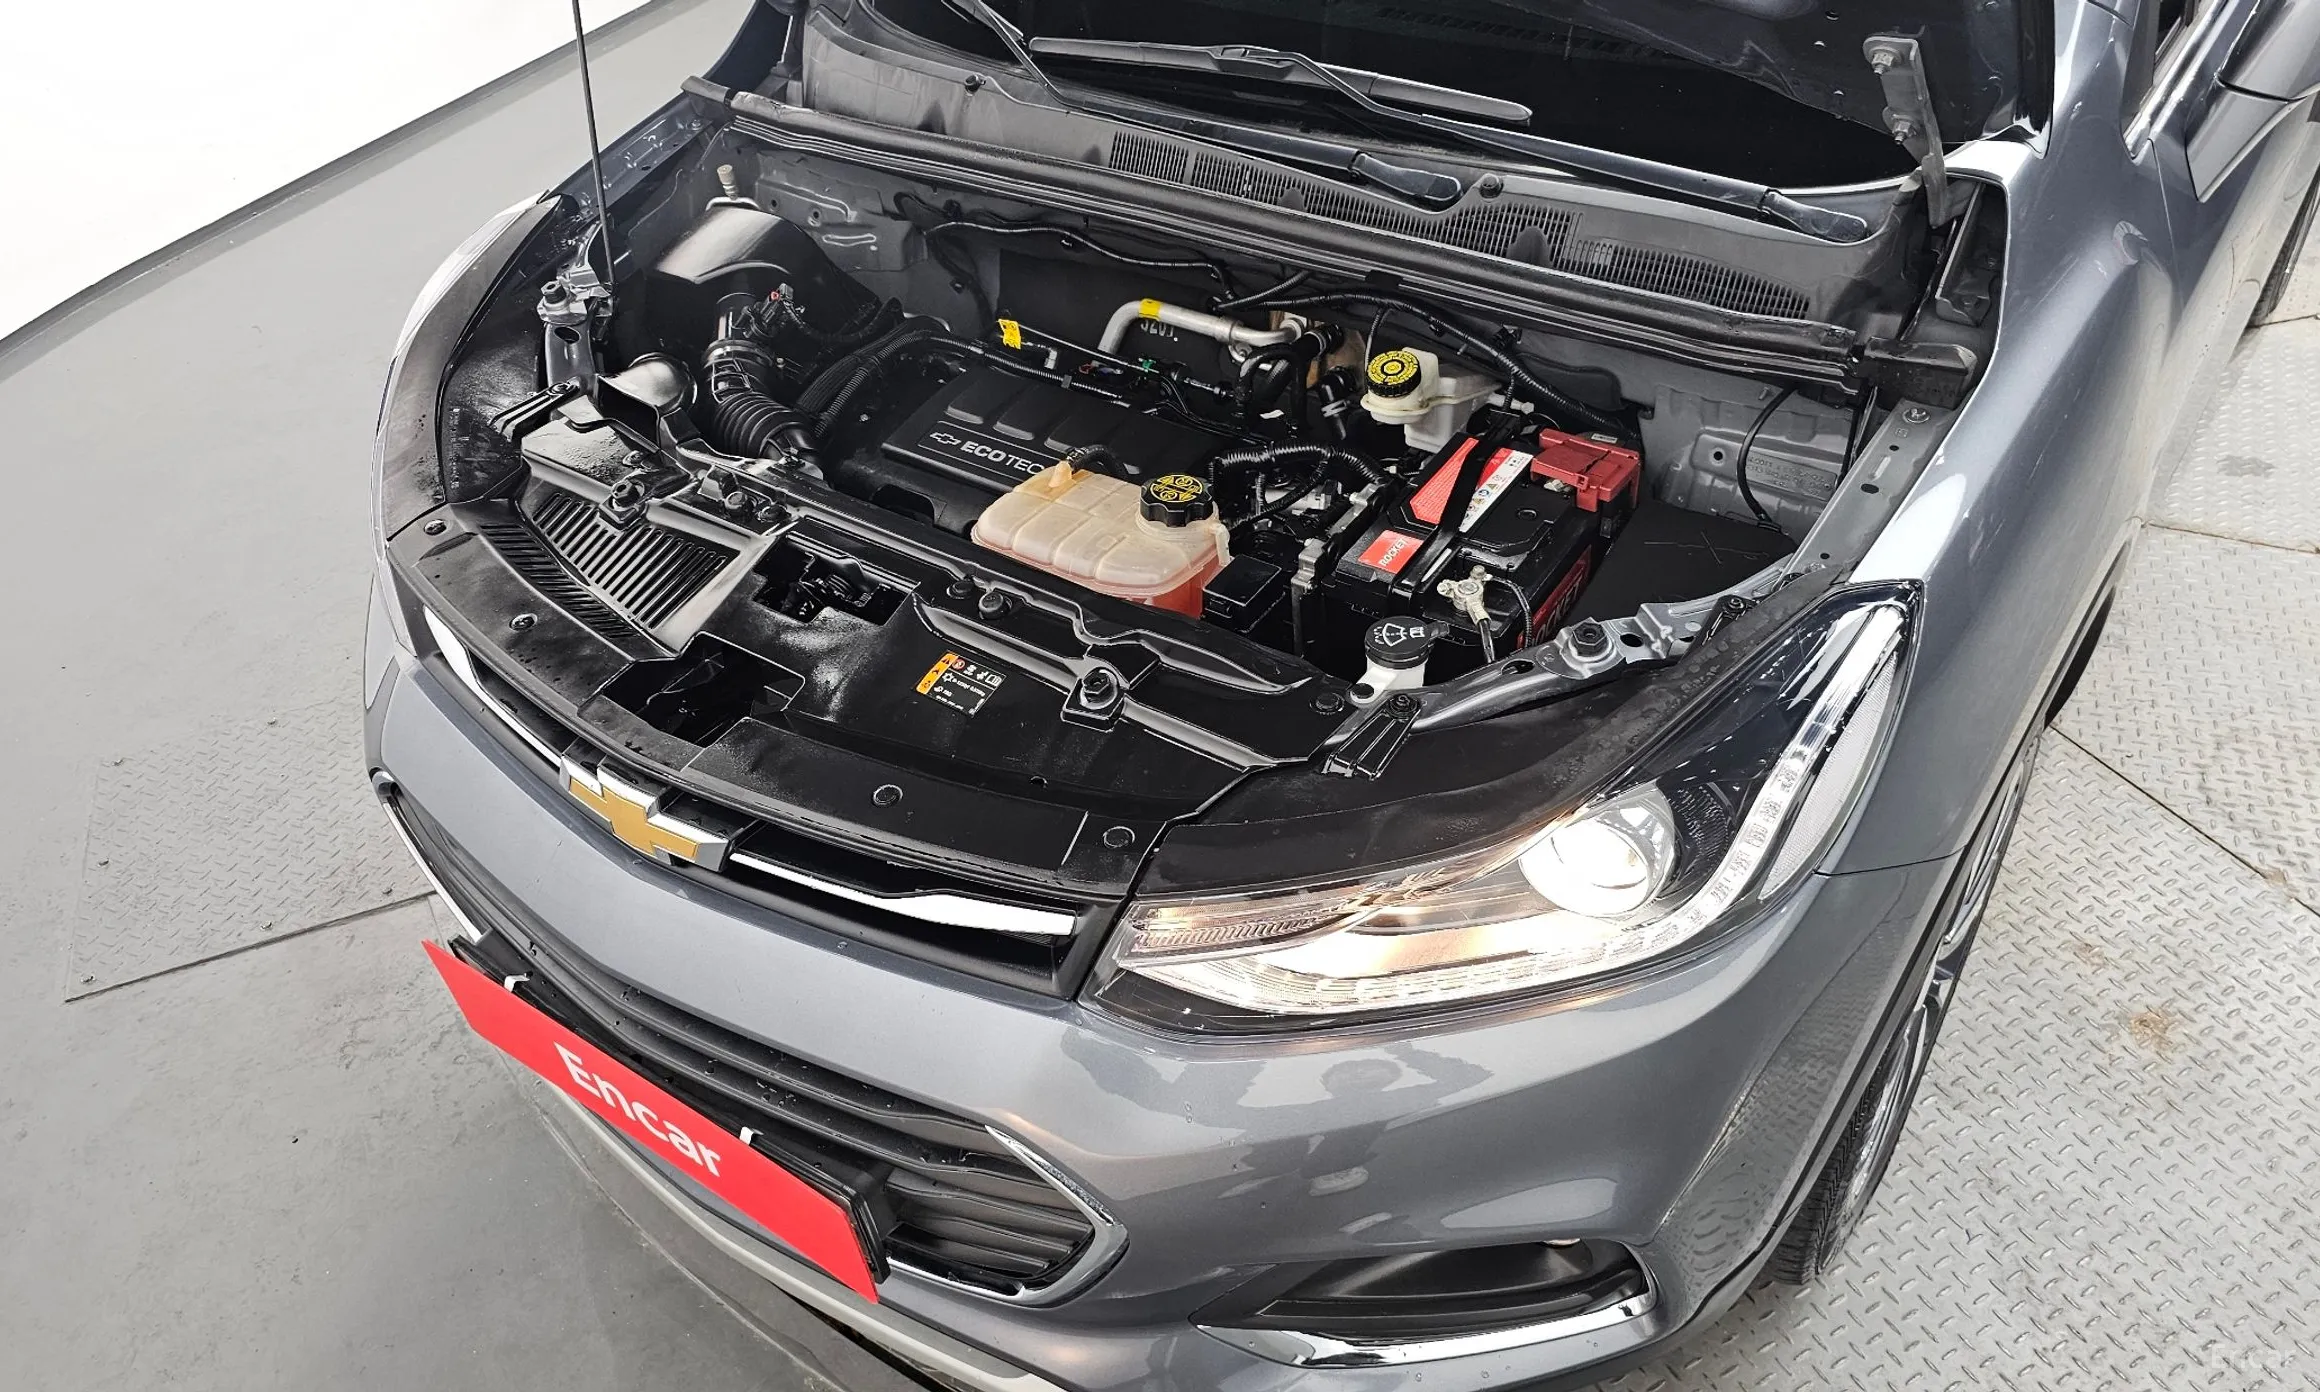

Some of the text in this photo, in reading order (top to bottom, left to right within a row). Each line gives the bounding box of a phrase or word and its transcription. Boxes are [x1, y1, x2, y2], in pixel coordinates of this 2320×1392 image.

[960, 440, 1045, 475] ECOTEC
[1378, 538, 1407, 566] ROCKET
[554, 1041, 721, 1177] Encar
